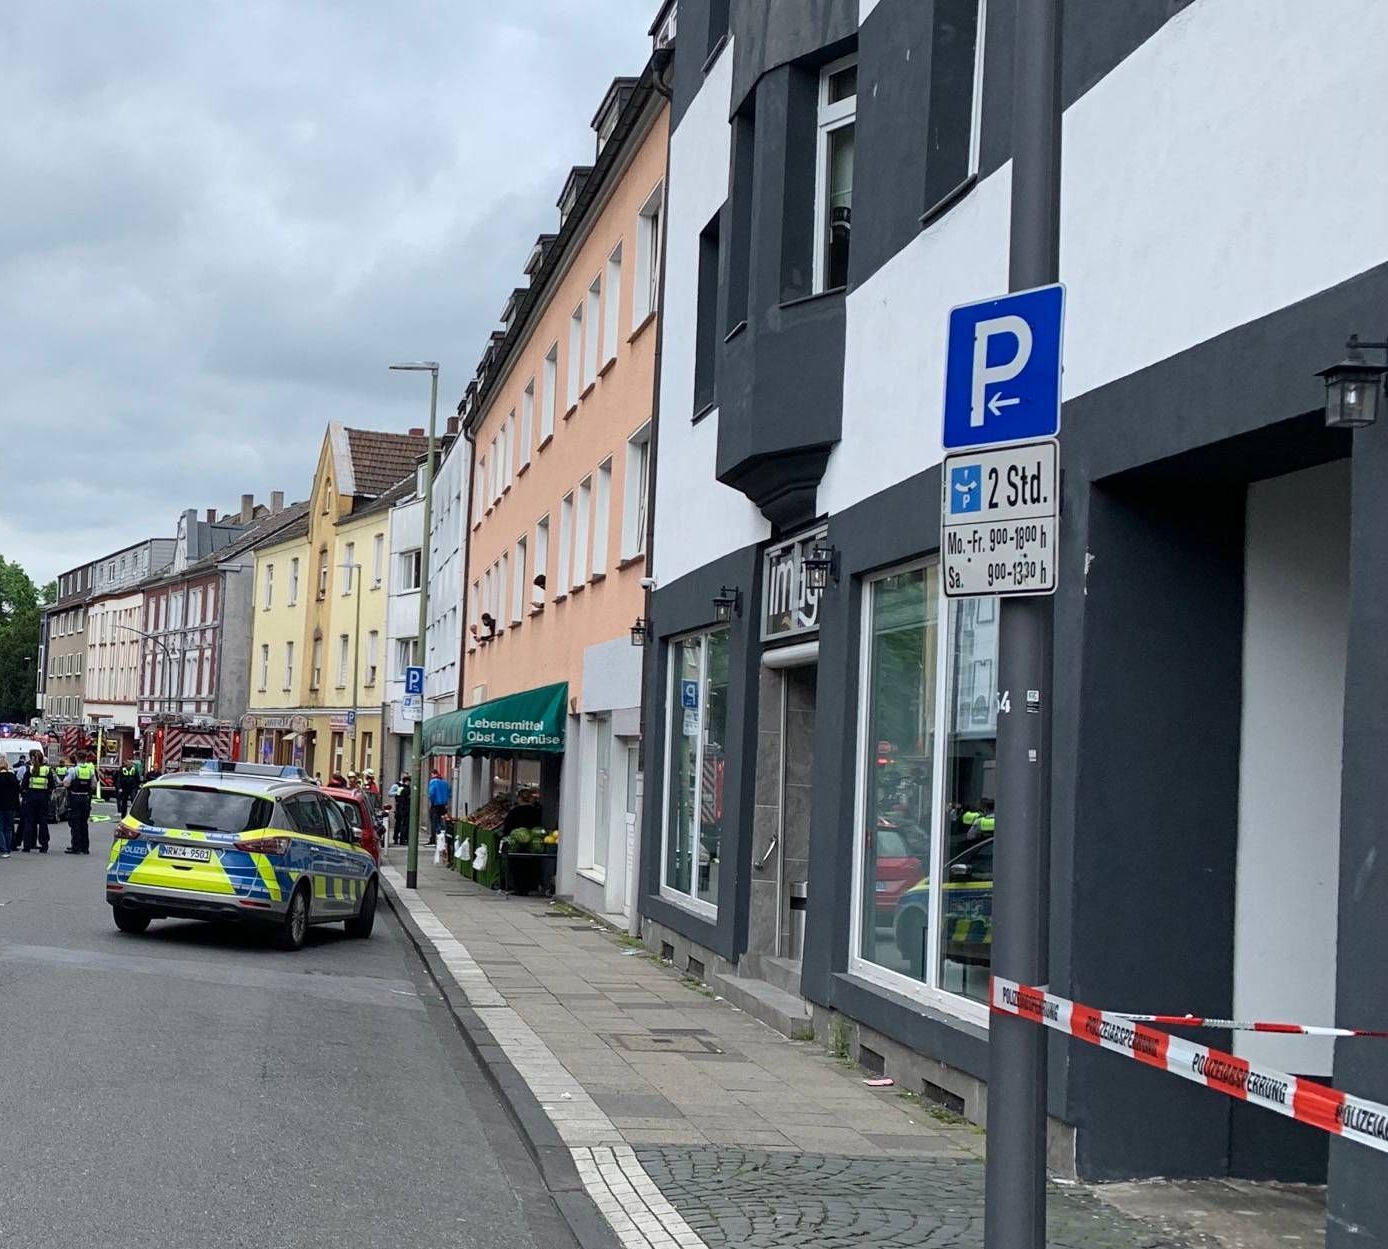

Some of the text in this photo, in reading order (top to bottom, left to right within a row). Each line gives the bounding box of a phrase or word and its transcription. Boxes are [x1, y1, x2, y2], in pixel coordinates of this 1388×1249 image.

[970, 315, 1033, 427] P
[988, 461, 1047, 509] 2 Std.
[963, 494, 970, 508] P
[1040, 524, 1046, 548] h
[948, 566, 964, 588] Sa.
[1040, 560, 1046, 584] h
[409, 670, 420, 690] P
[467, 717, 544, 731] Lebensmittel
[467, 731, 495, 742] Obst
[510, 733, 560, 744] Gemüse
[121, 845, 147, 855] POLIZEI
[190, 849, 210, 861] 9501
[1192, 1053, 1288, 1104] POLIZEIABSPERRUNG
